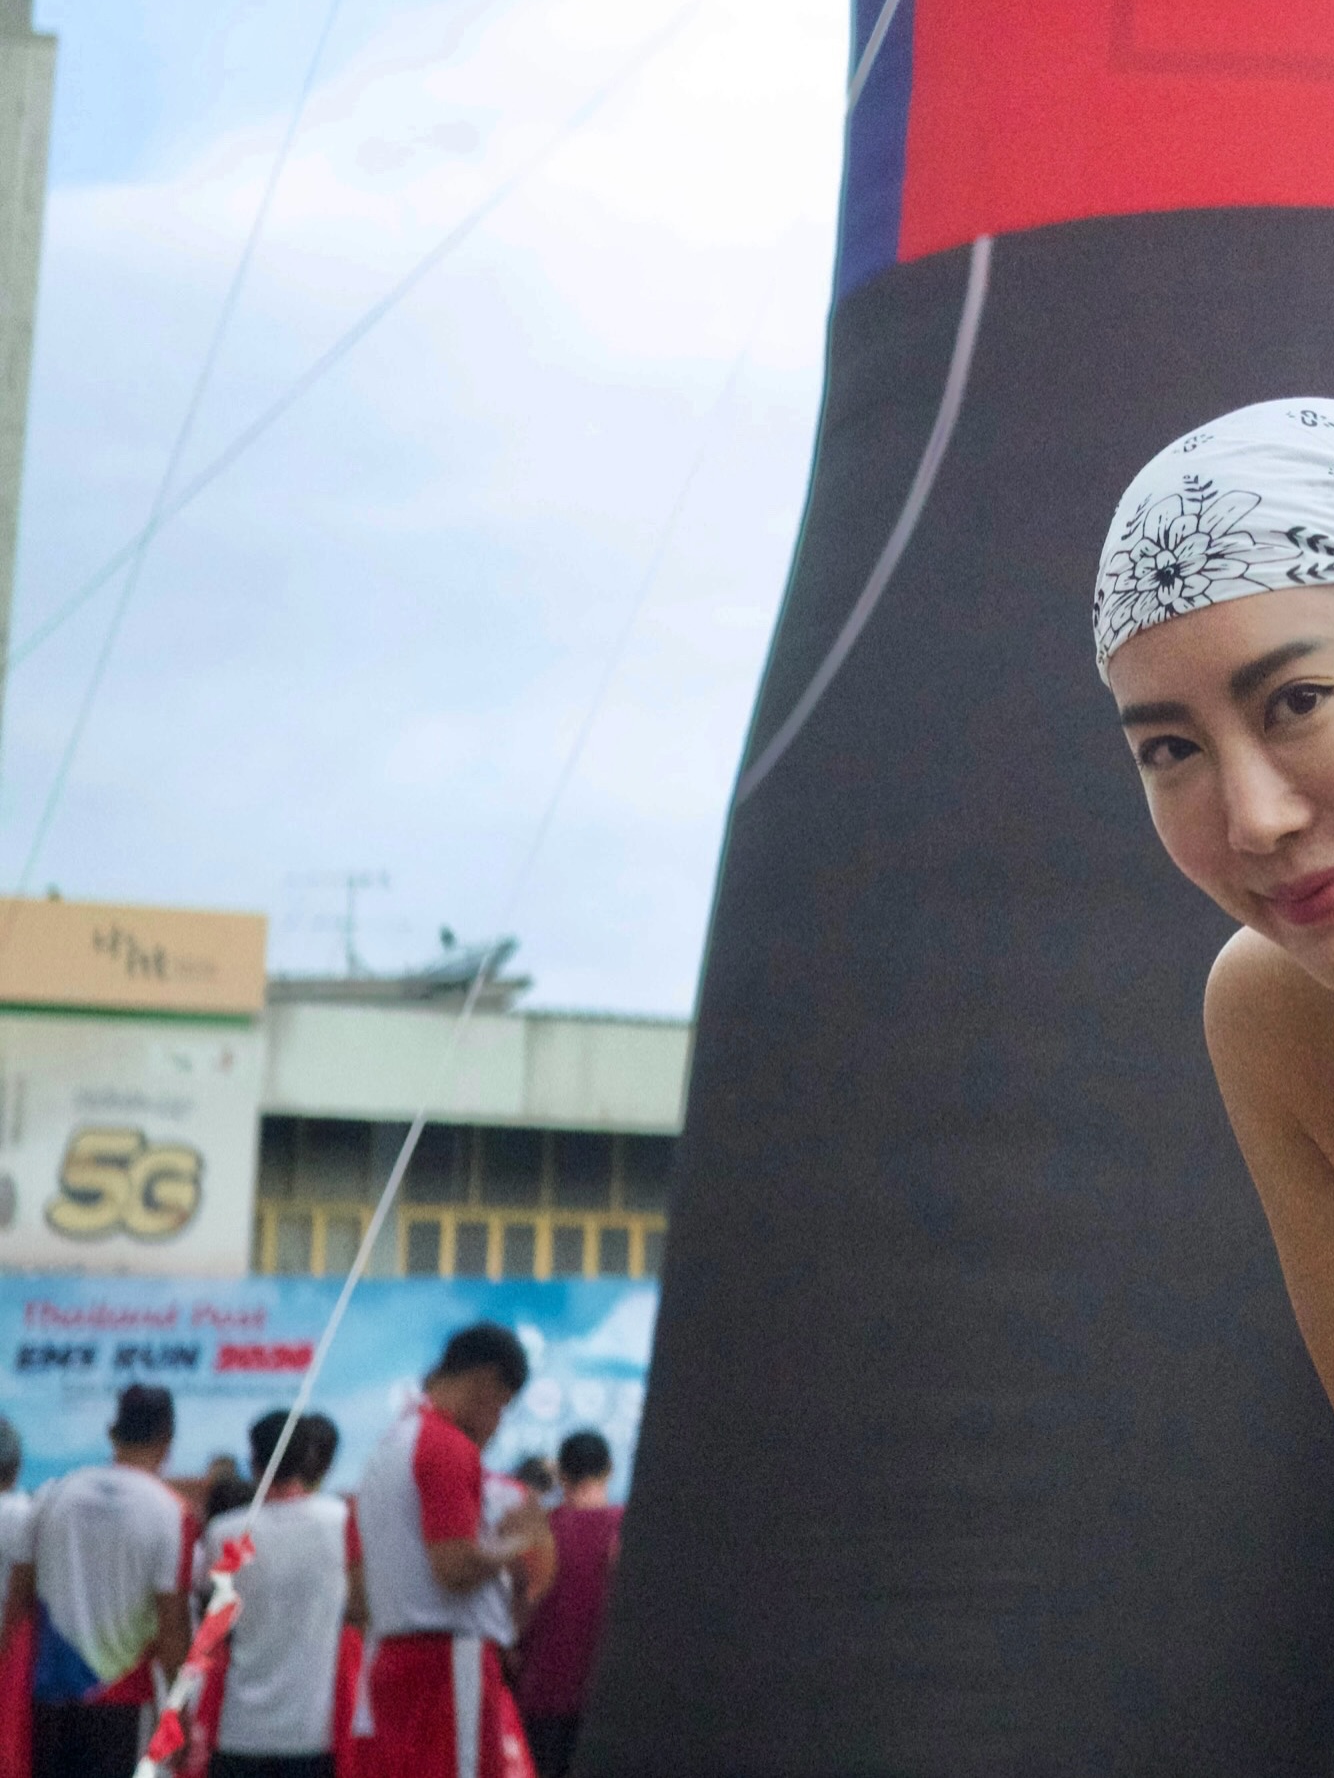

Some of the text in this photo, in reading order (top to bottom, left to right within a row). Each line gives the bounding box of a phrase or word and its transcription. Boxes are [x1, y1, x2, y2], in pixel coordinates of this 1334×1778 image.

[44, 1126, 206, 1242] 5G
[24, 1299, 180, 1329] Thailand
[112, 1340, 201, 1371] RUN
